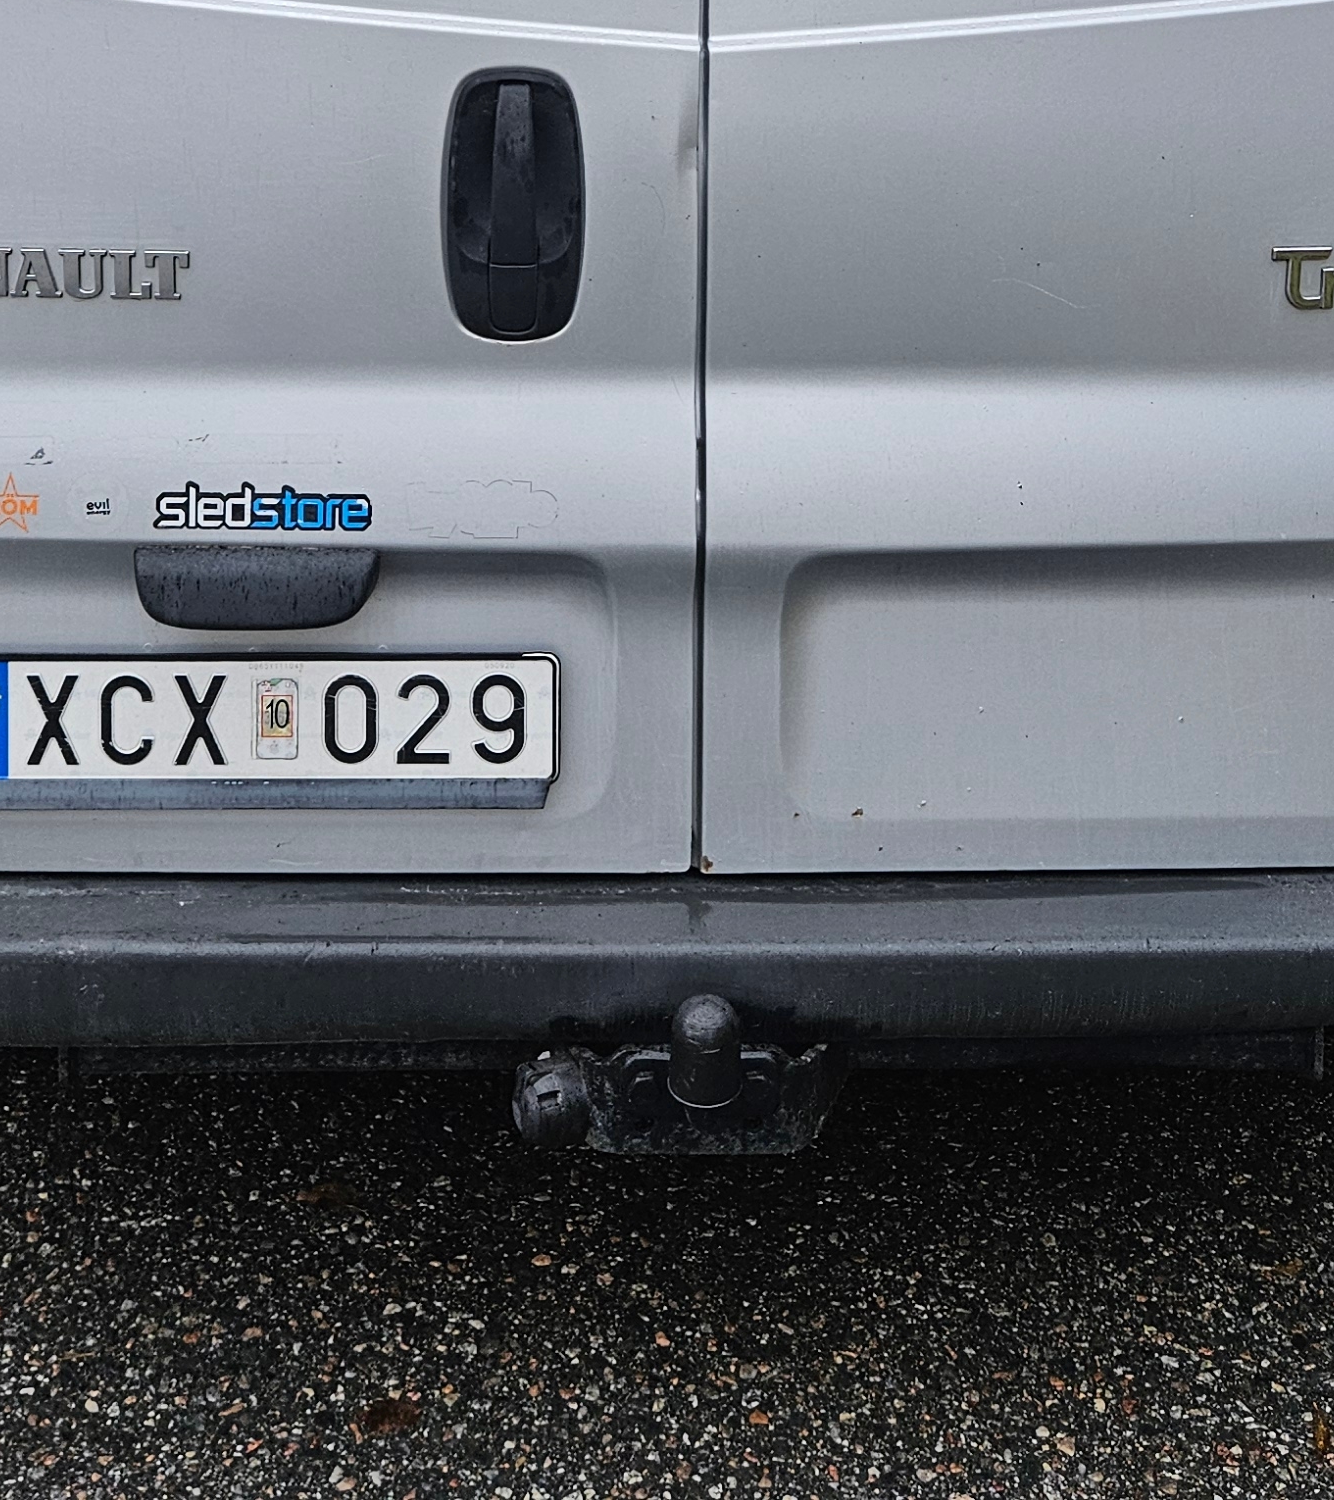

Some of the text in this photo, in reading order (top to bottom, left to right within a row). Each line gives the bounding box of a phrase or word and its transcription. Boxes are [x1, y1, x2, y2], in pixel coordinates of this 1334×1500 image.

[86, 498, 110, 510] evil
[155, 482, 371, 530] sledstore
[26, 674, 527, 766] XCX 029
[265, 699, 290, 729] 10
